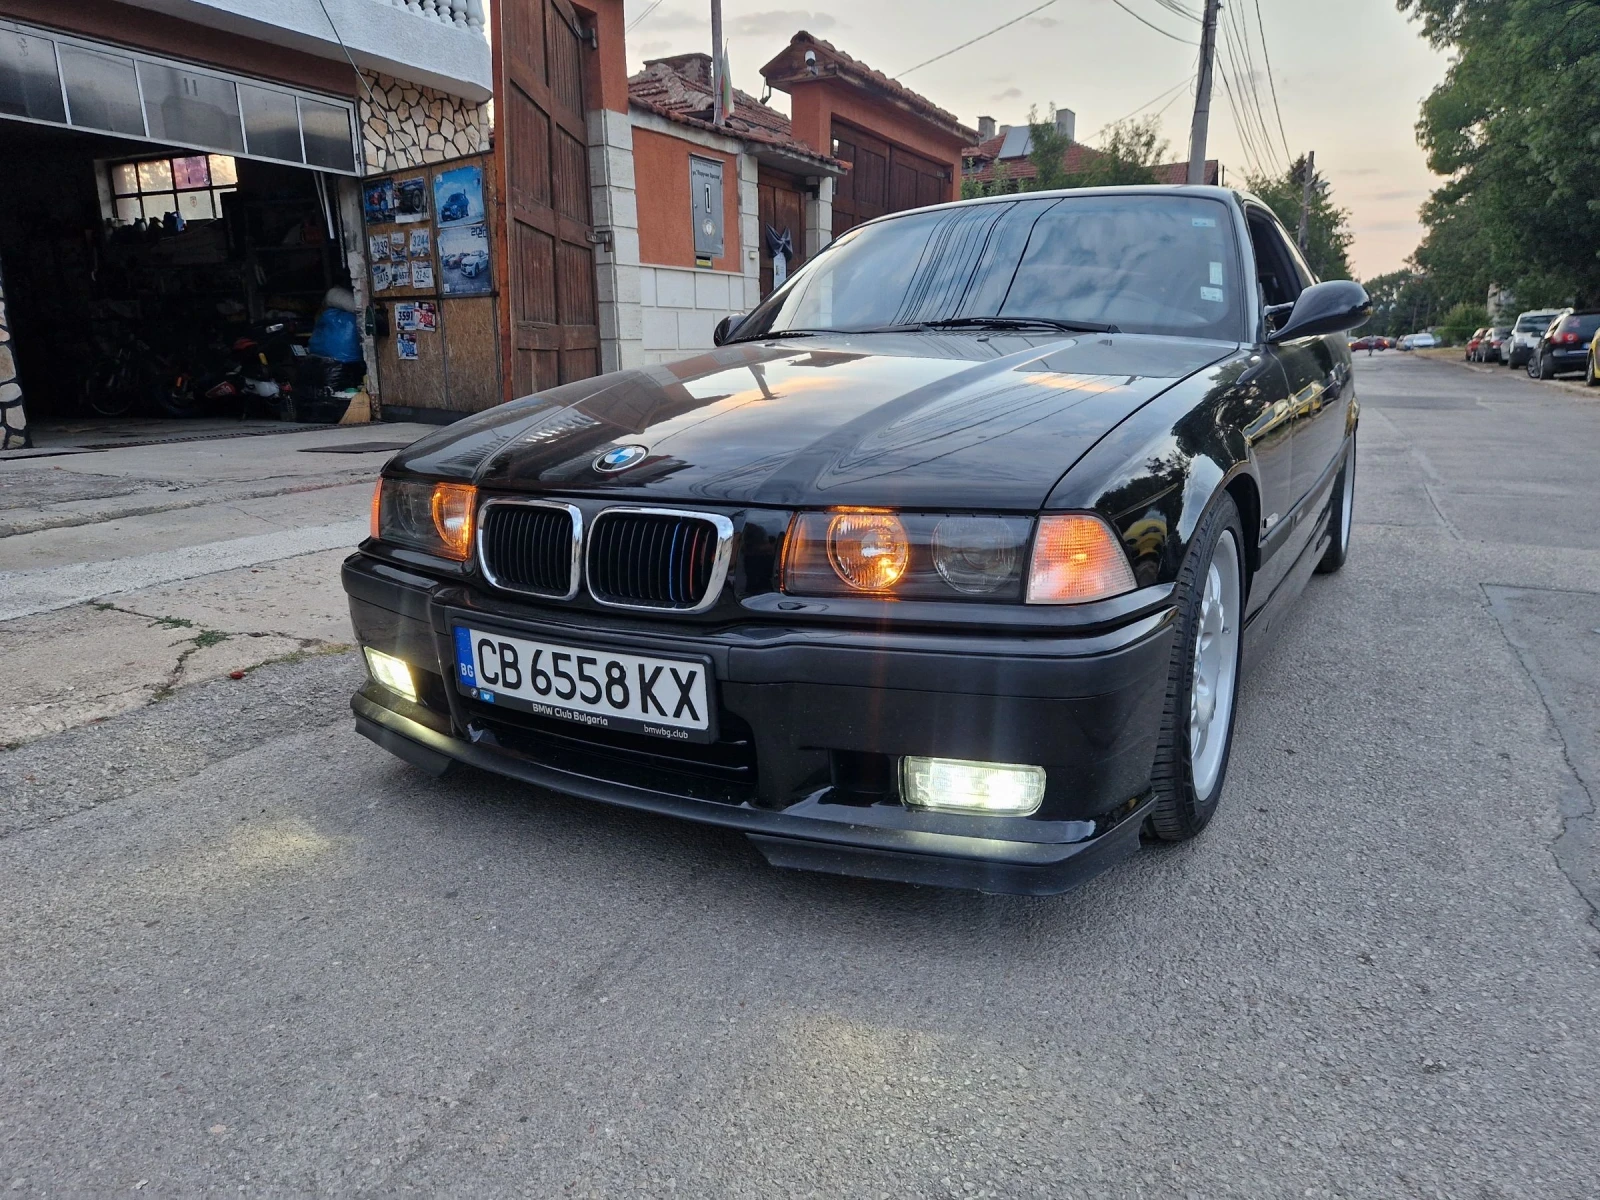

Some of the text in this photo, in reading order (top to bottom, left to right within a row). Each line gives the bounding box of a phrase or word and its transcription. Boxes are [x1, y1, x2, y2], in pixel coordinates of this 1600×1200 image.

[412, 234, 429, 247] 3244
[398, 310, 413, 321] 3591
[460, 662, 475, 678] BG
[477, 638, 701, 722] CB 6558 KX
[532, 702, 609, 726] BMW Club Bulgaria
[643, 724, 689, 740] bmwbg.club
